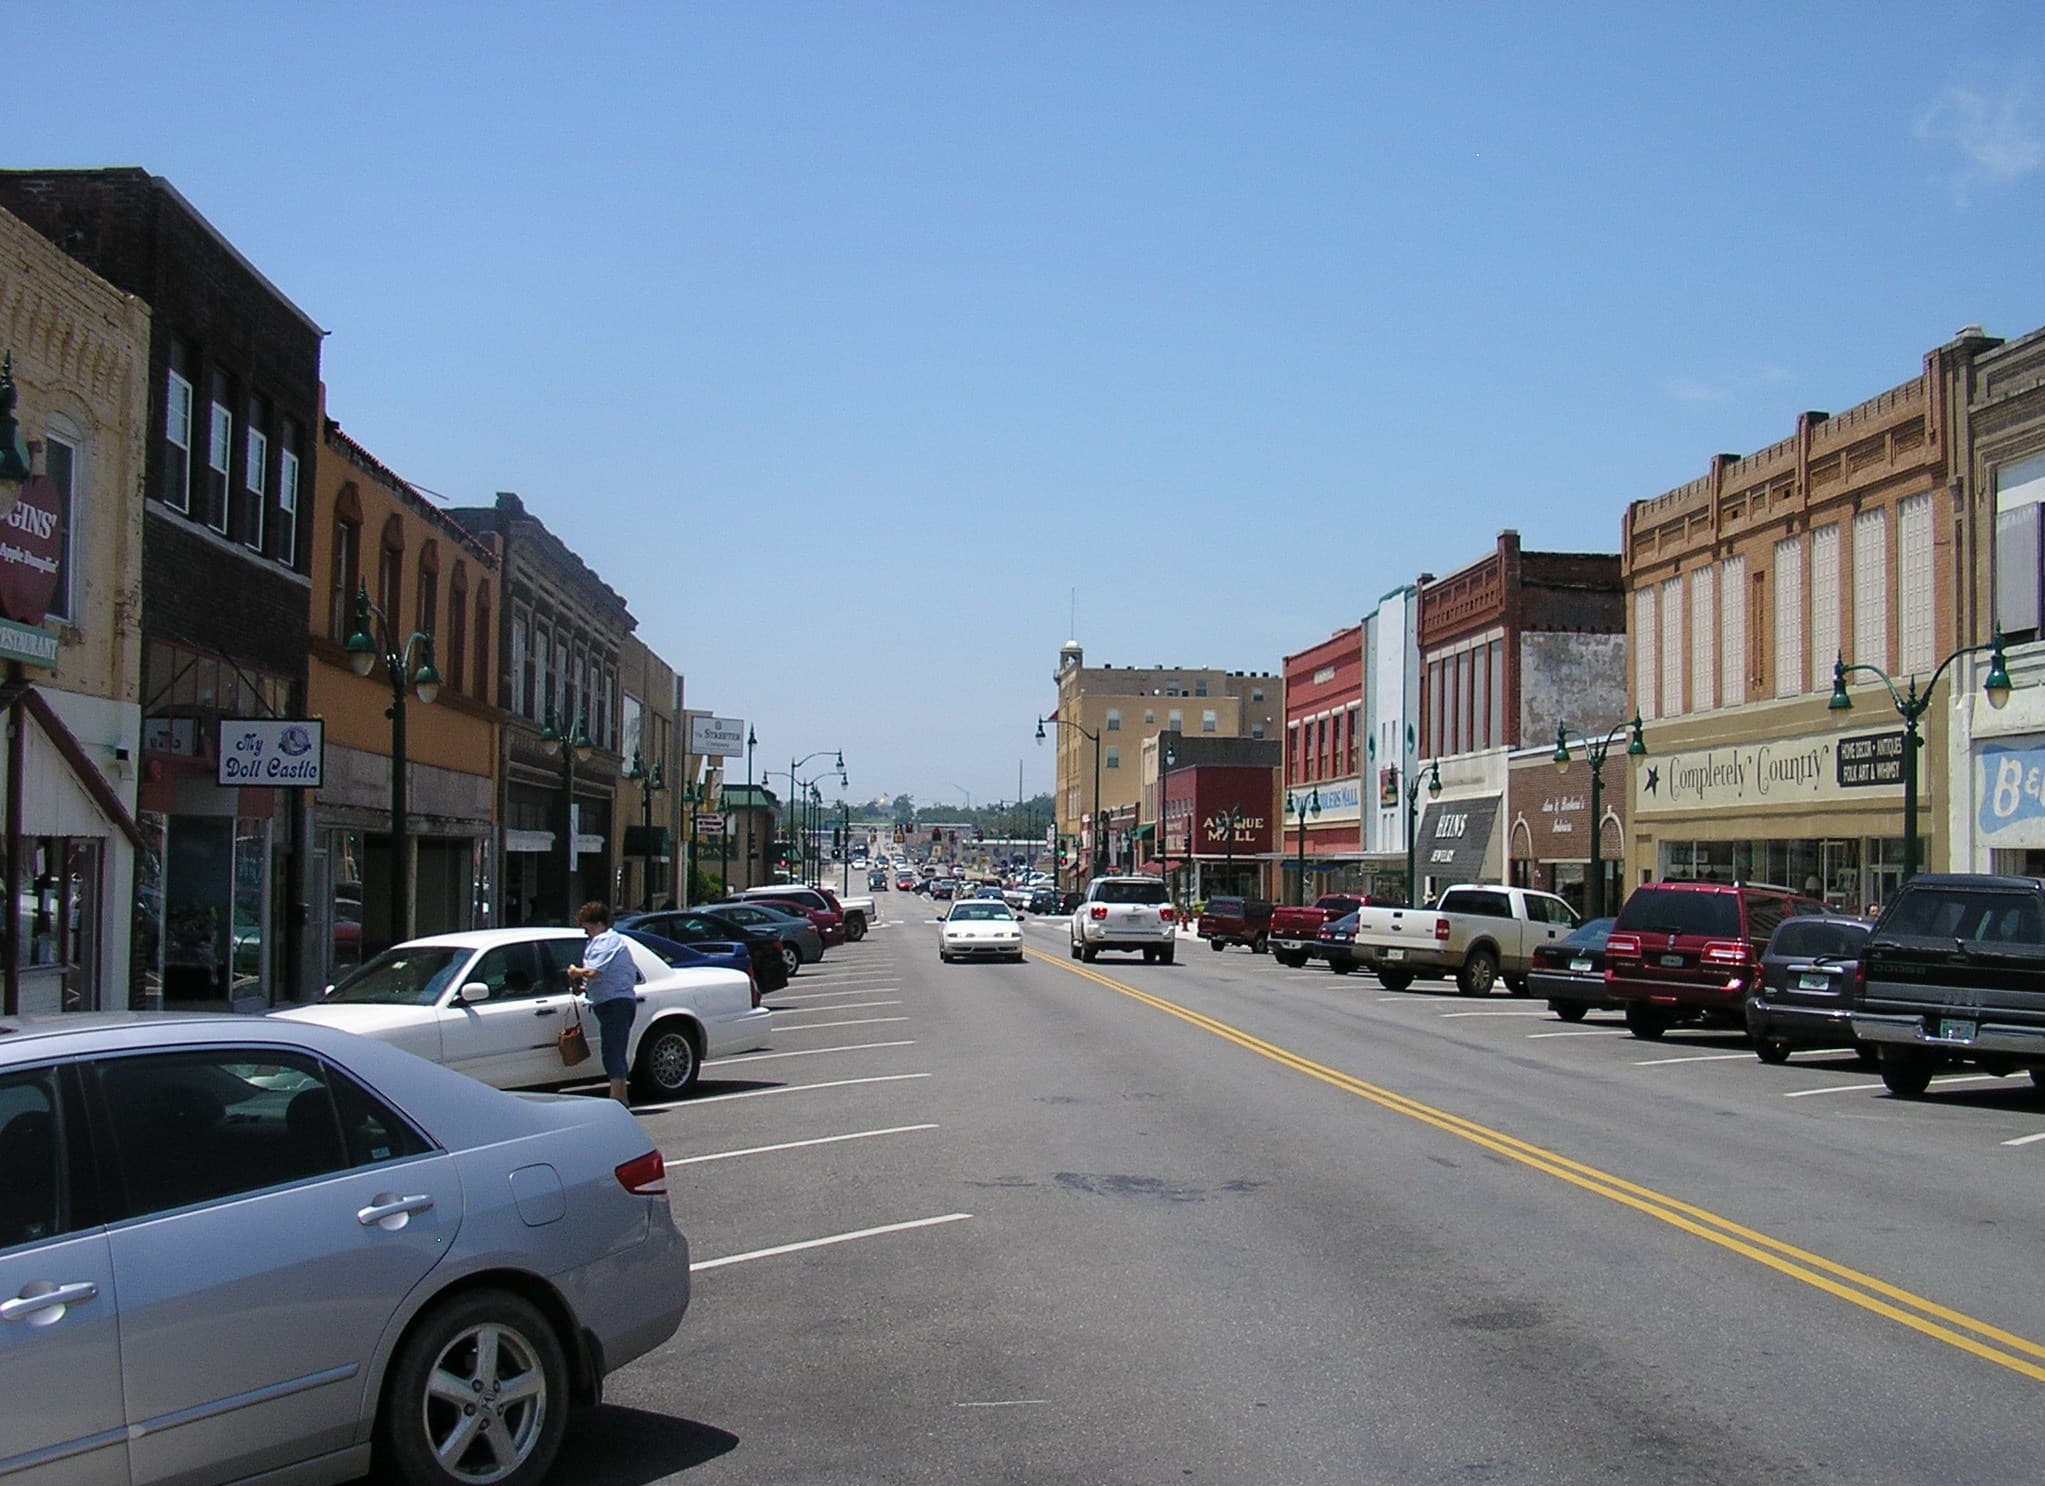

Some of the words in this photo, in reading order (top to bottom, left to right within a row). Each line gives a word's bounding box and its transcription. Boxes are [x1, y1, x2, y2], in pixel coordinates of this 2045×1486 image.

[5, 501, 57, 539] GINS'
[236, 733, 264, 756] My
[1841, 742, 1855, 759] HOME
[1856, 741, 1872, 758] DECOR
[1876, 737, 1902, 757] ANTIQUES
[226, 757, 261, 778] Doll
[267, 757, 317, 778] Castle
[1670, 750, 1752, 801] Completely
[1757, 745, 1829, 795] Country
[1843, 765, 1857, 782] FOLK
[1859, 764, 1870, 780] ART
[1203, 817, 1264, 829] AQUE
[1435, 813, 1468, 838] HEINS
